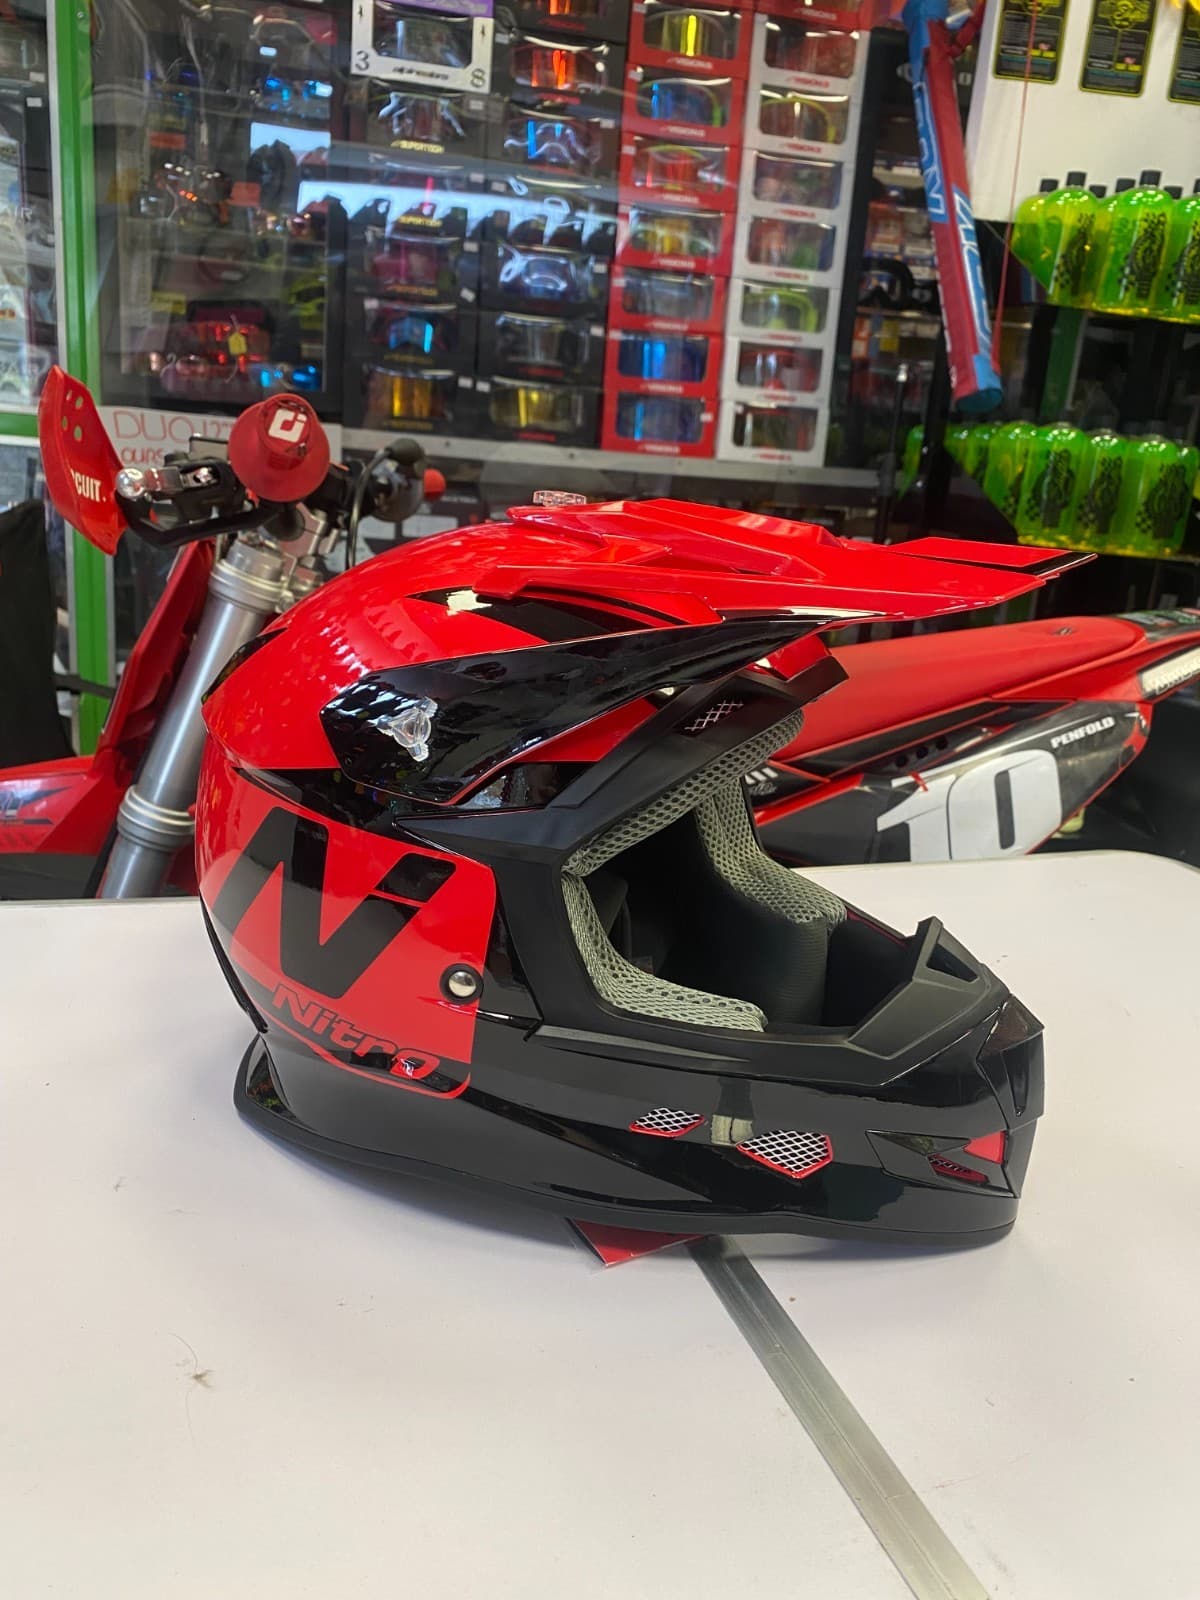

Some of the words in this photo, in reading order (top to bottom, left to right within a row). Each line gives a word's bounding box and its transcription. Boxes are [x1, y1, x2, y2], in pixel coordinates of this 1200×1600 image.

[355, 50, 370, 71] 3
[1050, 716, 1116, 749] PENFOLD
[272, 983, 440, 1080] Nitro
